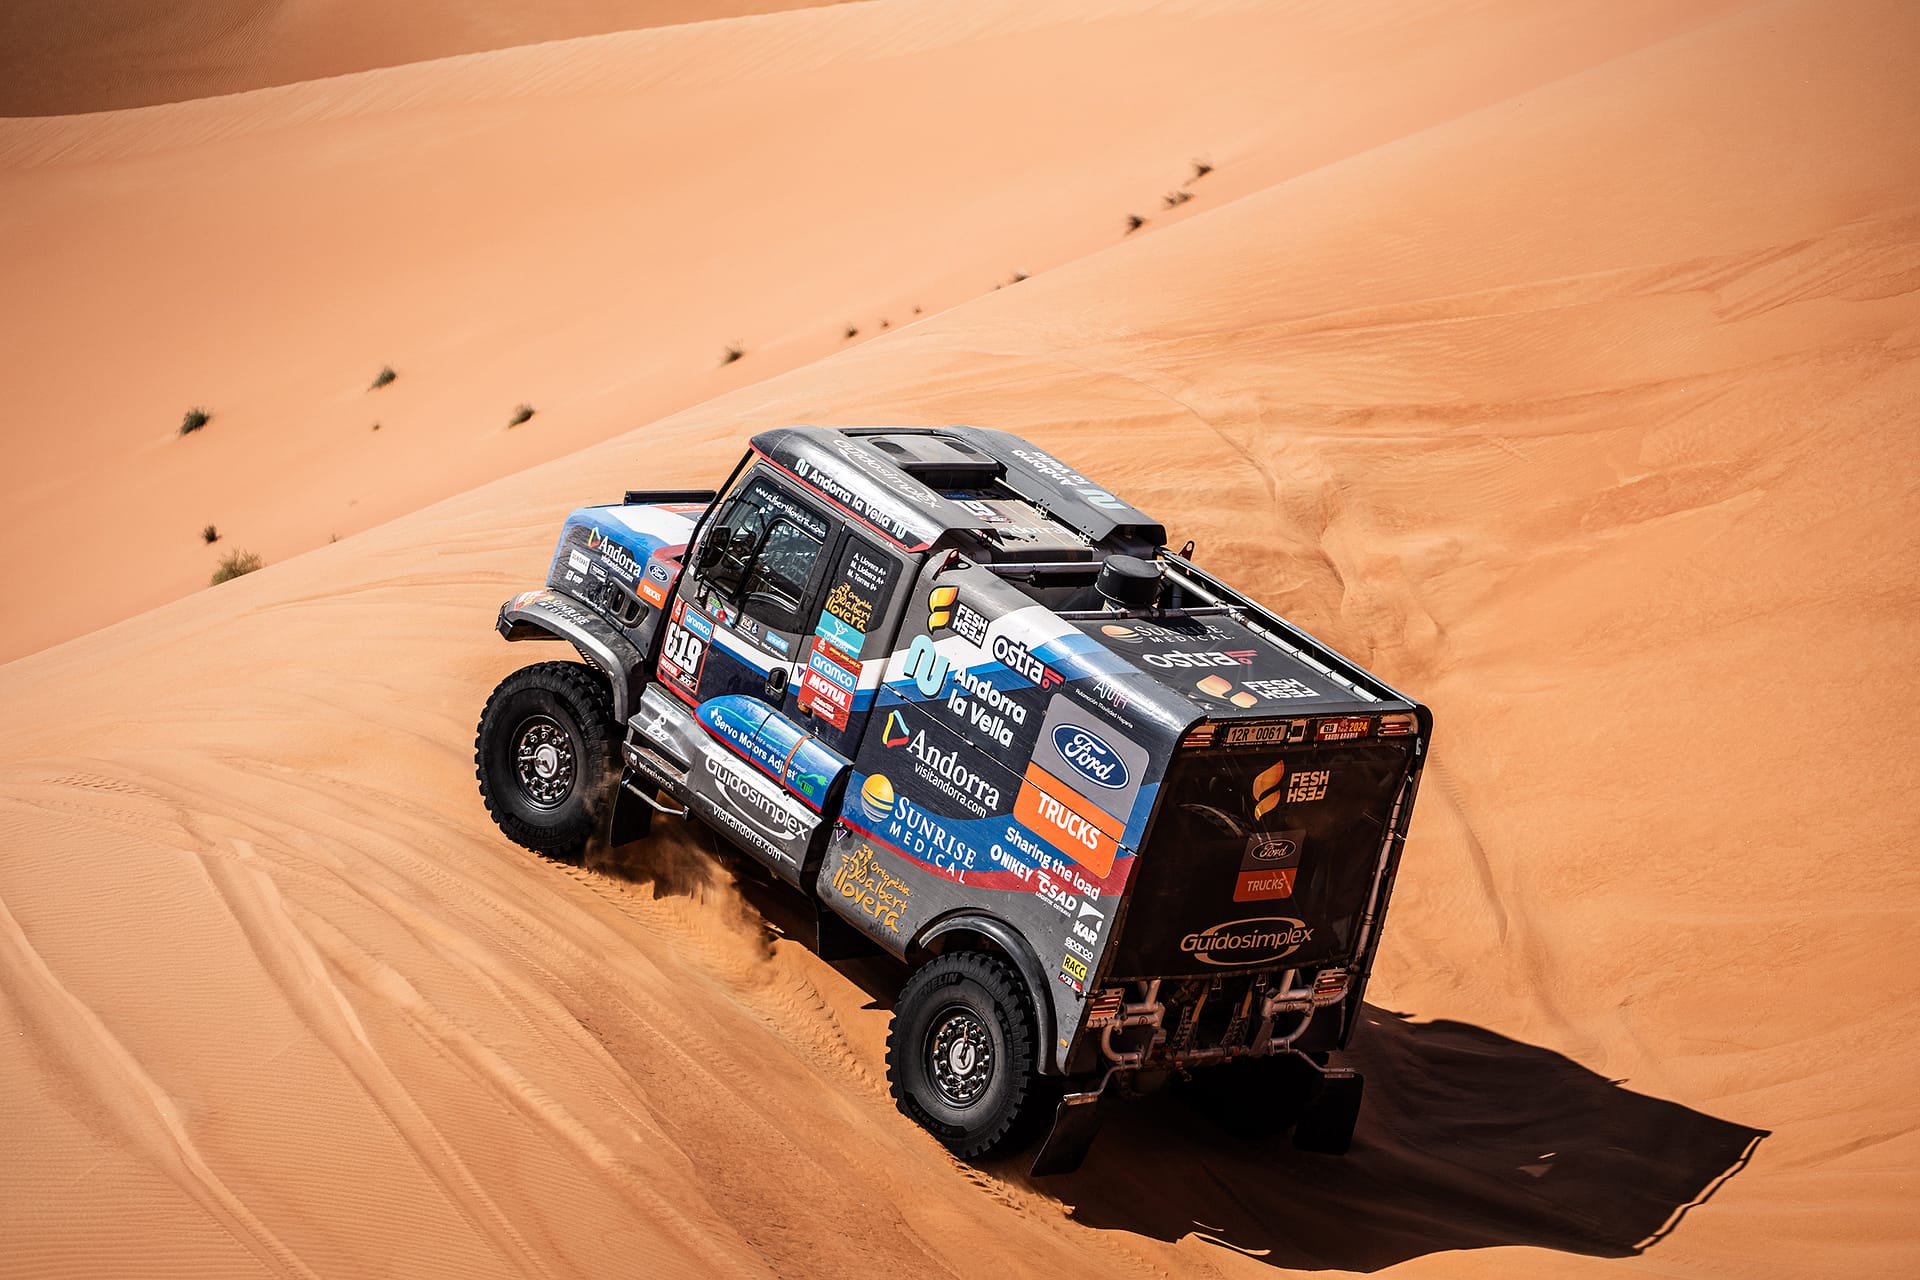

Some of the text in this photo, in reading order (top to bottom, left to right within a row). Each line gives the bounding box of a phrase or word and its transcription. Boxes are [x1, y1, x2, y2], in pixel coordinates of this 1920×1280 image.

[833, 438, 939, 509] Guidosimplex
[1011, 449, 1078, 486] Andorra
[1032, 451, 1070, 474] Vella
[809, 465, 892, 530] Andorra la Vella
[599, 535, 641, 578] Andorra
[850, 560, 857, 570] M.
[853, 552, 860, 561] A.
[860, 555, 879, 572] Llovera
[643, 584, 661, 601] TRUCKS
[847, 569, 854, 578] M.
[854, 573, 870, 588] Torres
[686, 614, 710, 636] aramco
[825, 595, 866, 633] llovera
[846, 601, 871, 621] albert
[956, 603, 989, 633] FESH
[664, 622, 702, 674] 619
[994, 637, 1045, 685] ostra
[1142, 650, 1241, 668] ostra
[661, 657, 678, 677] MOTUL
[813, 656, 853, 688] aramco
[808, 674, 846, 707] MOTUL
[954, 667, 1027, 725] Andorra
[1241, 678, 1306, 691] FESH
[947, 688, 1014, 749] la Vella
[1231, 726, 1282, 742] 12R 0061
[1349, 721, 1368, 732] 2024
[714, 716, 738, 740] Servo
[739, 732, 767, 760] Motors
[1324, 731, 1359, 741] SAUDI ARABIA
[906, 729, 1001, 811] Andorra
[1064, 732, 1113, 781] Ford
[913, 762, 987, 819] visitandorra.com
[1289, 770, 1330, 788] FESH
[705, 754, 809, 841] Guidosimplex
[712, 805, 782, 861] visitandorra.com
[894, 796, 978, 870] SUNRISE
[1036, 791, 1101, 851] TRUCKS
[888, 824, 966, 885] MEDICAL
[1004, 826, 1101, 902] Sharing the load
[832, 866, 900, 934] llovera
[865, 878, 908, 915] albert
[1038, 876, 1078, 912] CSAD
[1247, 877, 1284, 892] TRUCKS
[1053, 902, 1072, 918] OSTRAVA
[1064, 936, 1094, 960] sparco
[1072, 919, 1098, 947] KAR
[1180, 927, 1314, 952] Guidosimplex
[1064, 956, 1086, 979] RACC
